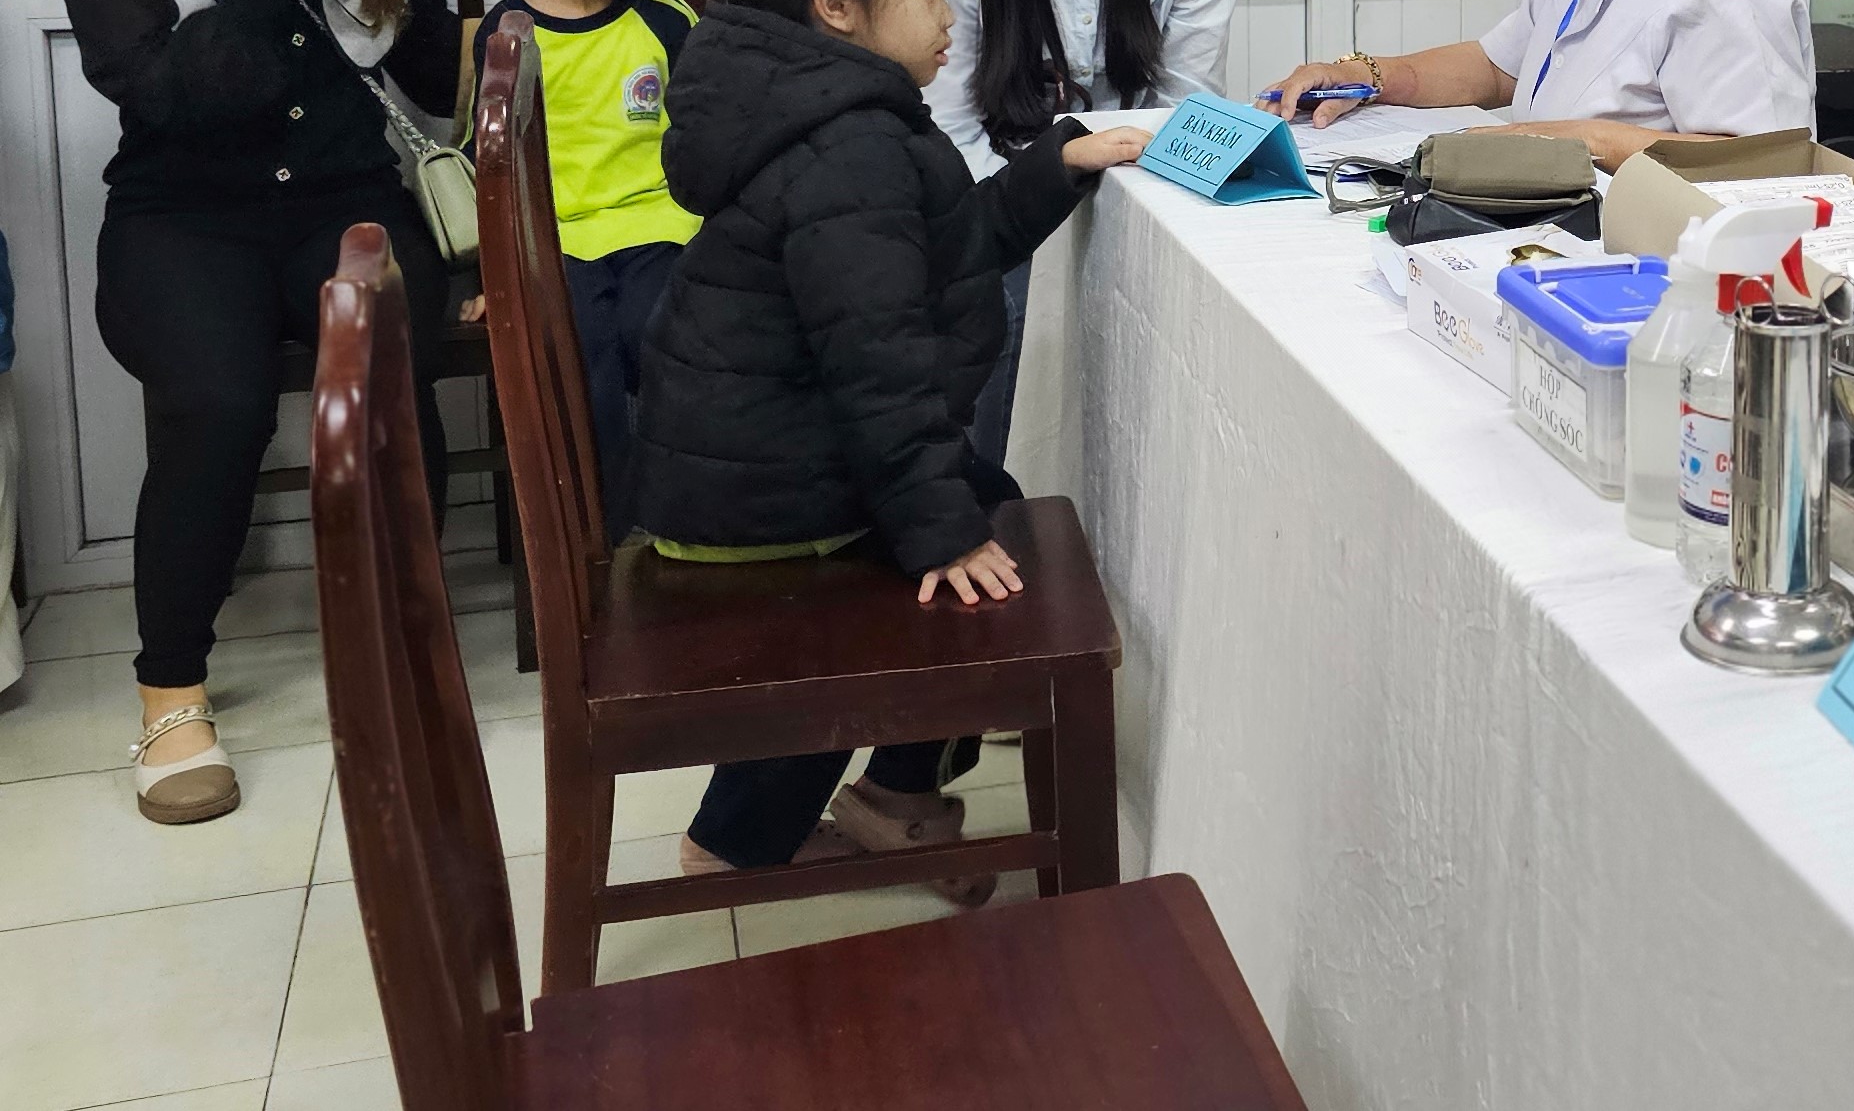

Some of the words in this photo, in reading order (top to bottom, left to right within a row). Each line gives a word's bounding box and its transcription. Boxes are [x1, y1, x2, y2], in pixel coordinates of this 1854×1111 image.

[1540, 365, 1561, 401] HỘP
[1523, 386, 1557, 432] CHỐNG
[1560, 417, 1582, 452] SỐC
